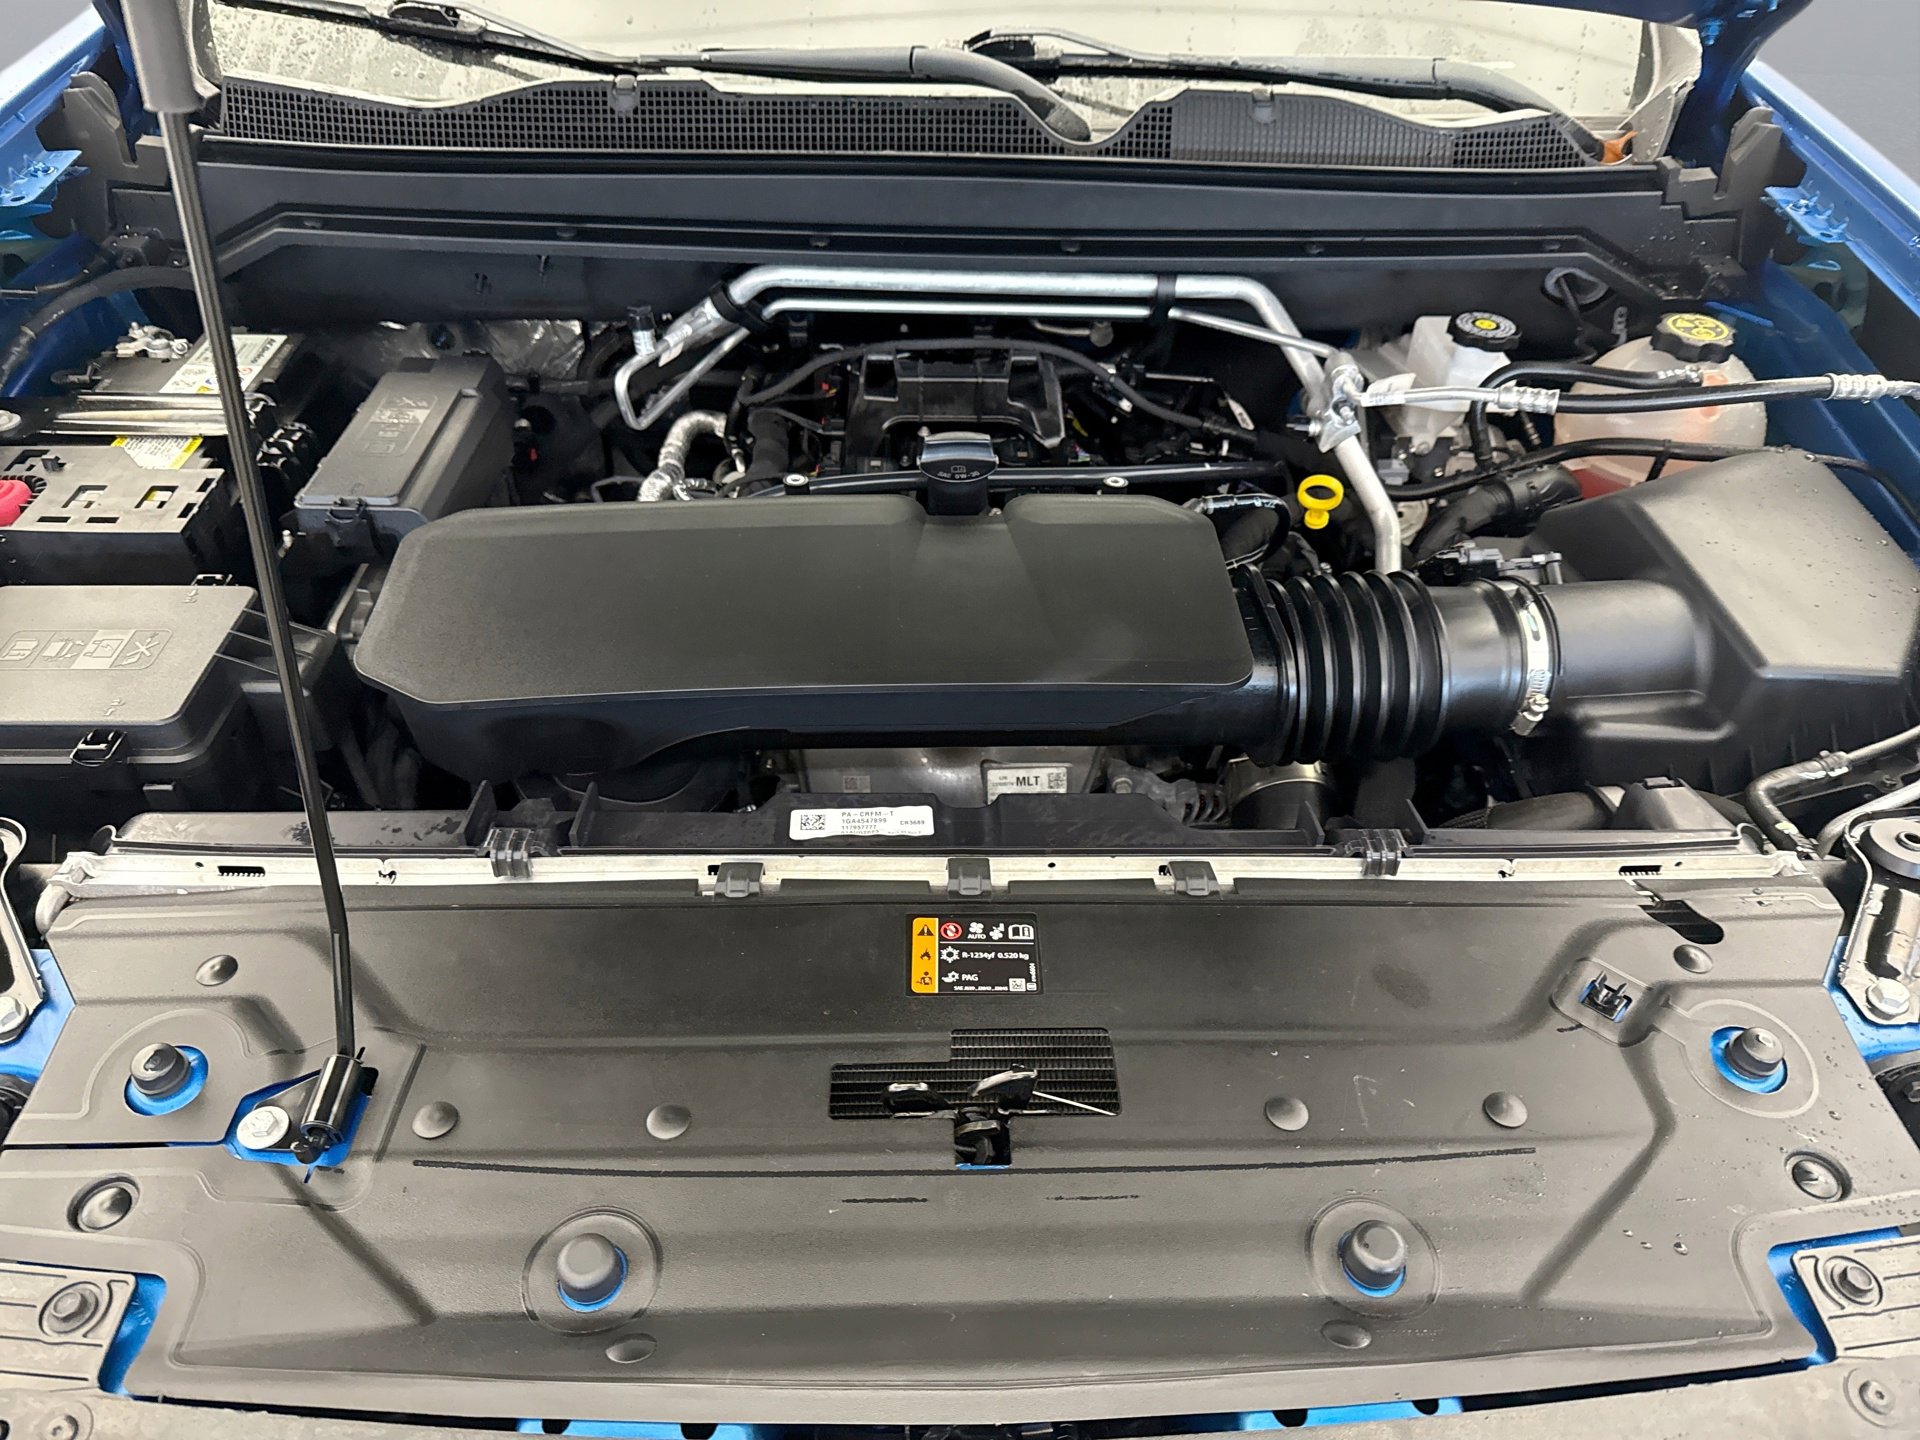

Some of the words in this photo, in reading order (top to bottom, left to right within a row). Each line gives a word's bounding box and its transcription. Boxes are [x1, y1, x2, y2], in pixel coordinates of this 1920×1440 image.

[1015, 776, 1041, 787] MLT
[962, 952, 995, 960] R-1234yf
[1019, 952, 1029, 960] kg
[962, 973, 979, 981] PAG
